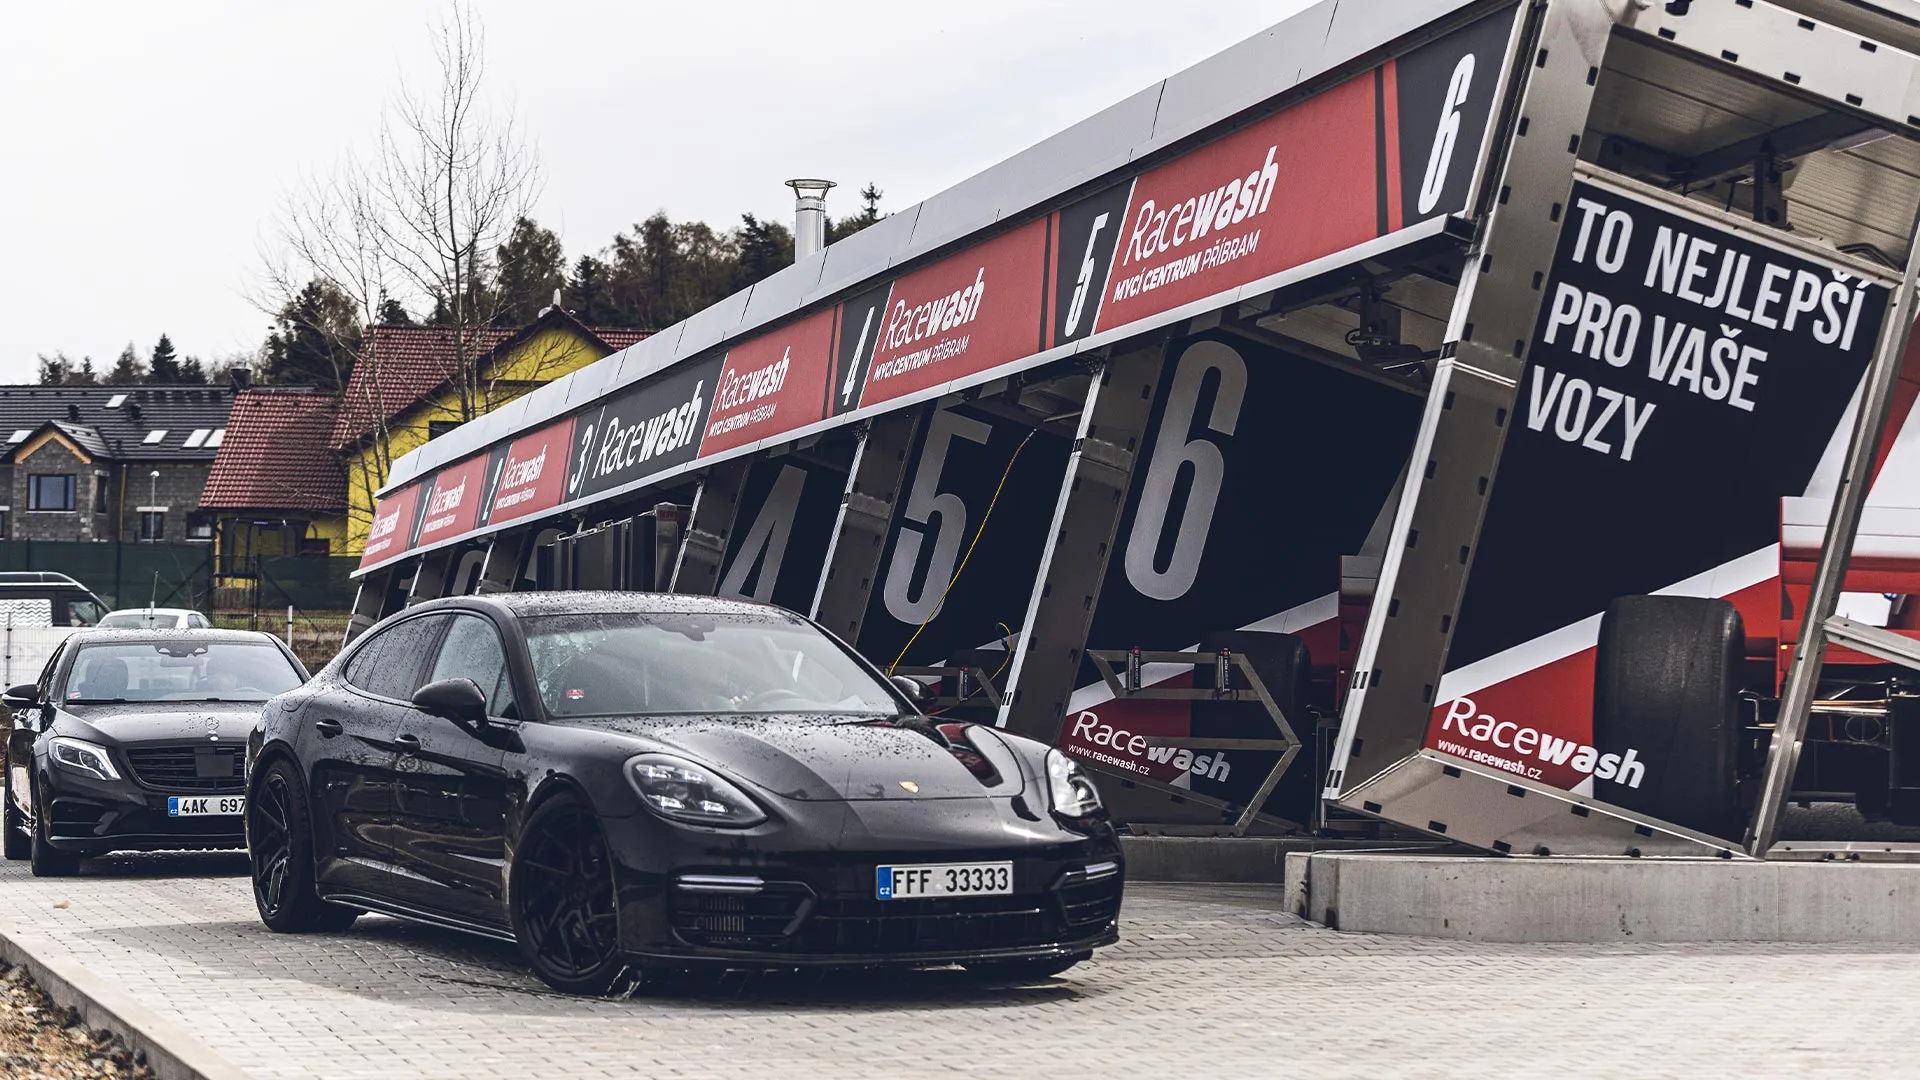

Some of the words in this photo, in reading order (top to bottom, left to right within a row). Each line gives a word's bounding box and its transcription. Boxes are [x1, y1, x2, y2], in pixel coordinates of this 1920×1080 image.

[1418, 53, 1475, 215] 6
[1123, 145, 1279, 267] Racewash
[882, 267, 985, 353] Racewash
[1064, 211, 1110, 338] 5
[1112, 267, 1146, 304] MYCÍ
[1142, 252, 1202, 293] CENTRUM
[1200, 229, 1261, 272] PŘÍBRAM
[1572, 197, 1634, 274] TO
[1643, 225, 1873, 351] NEJLEPŠÍ
[716, 345, 791, 412] Racewash
[842, 306, 875, 407] 4
[873, 355, 897, 383] MYCÍ
[892, 347, 932, 376] CENTRUM
[930, 334, 970, 364] PŘÍBRAM
[1543, 281, 1642, 368] PRO
[1647, 315, 1769, 413] VAŠE
[592, 380, 703, 479] Racewash
[1527, 365, 1657, 462] VOZY
[500, 444, 548, 490] Racewash
[569, 424, 593, 494] 3
[1124, 340, 1248, 601] 6
[718, 464, 807, 603] 4
[883, 405, 993, 626] 5
[1068, 743, 1150, 777] www.racewash.cz
[1071, 711, 1231, 783] Racewash
[1437, 738, 1543, 780] www.racewash.cz
[1441, 697, 1646, 789] Racewash
[181, 799, 208, 813] 4AK
[220, 798, 246, 813] 697
[879, 887, 891, 895] CZ
[892, 869, 933, 895] FFF
[945, 867, 1009, 893] 33333
